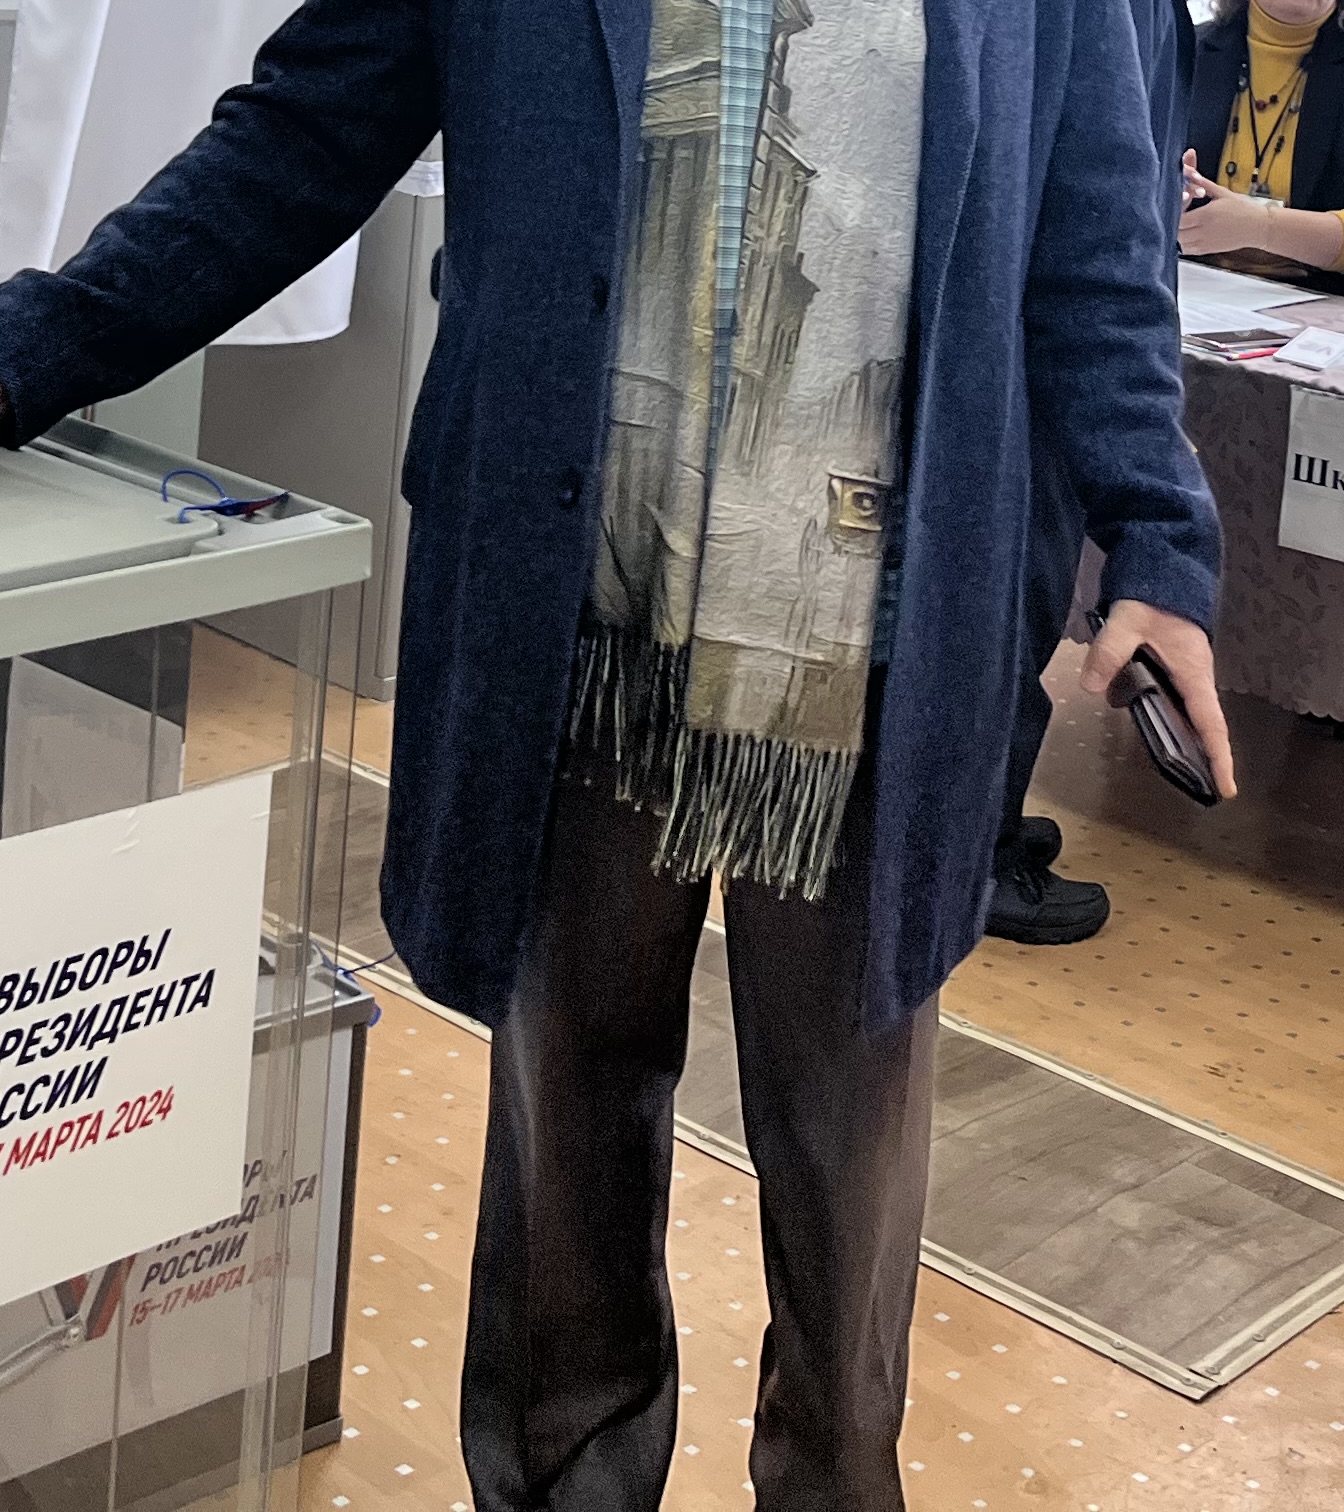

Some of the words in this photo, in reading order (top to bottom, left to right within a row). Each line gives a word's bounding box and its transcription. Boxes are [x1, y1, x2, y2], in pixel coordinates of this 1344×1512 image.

[3, 1110, 104, 1182] МАРТА
[105, 1085, 175, 1143] 2024
[140, 1231, 249, 1292] РОССИИ
[181, 1264, 247, 1308] МАРТА
